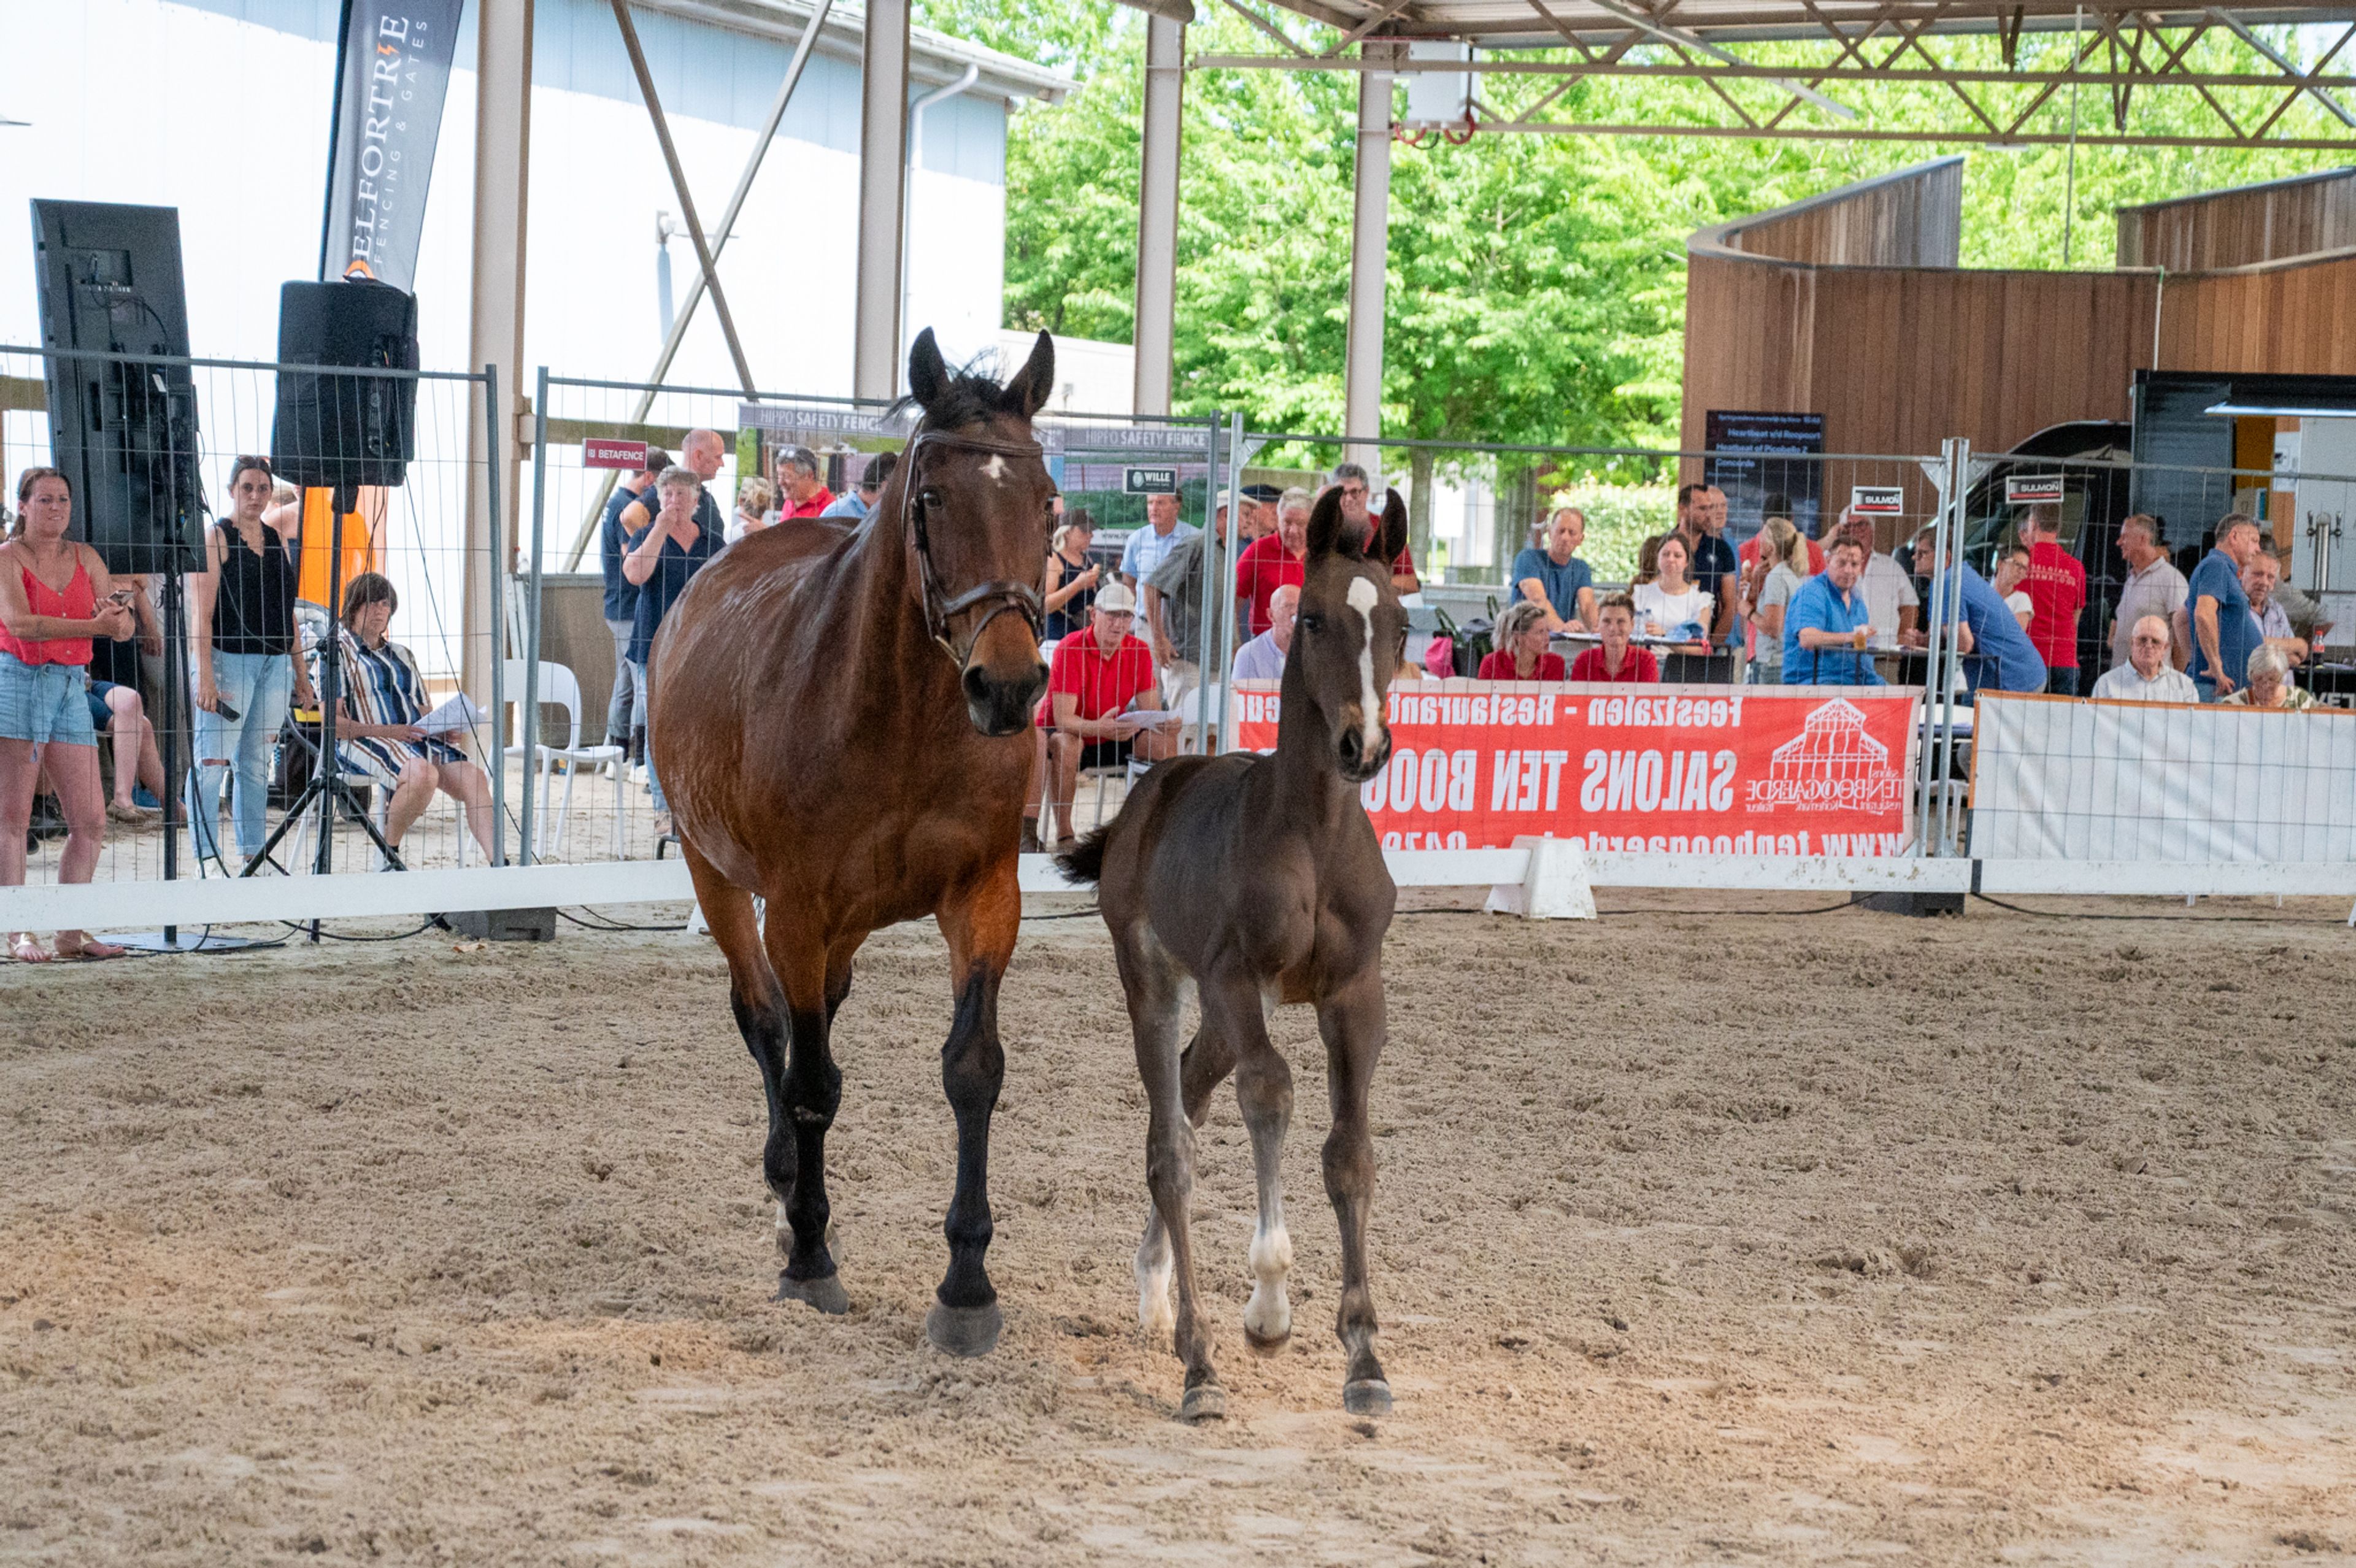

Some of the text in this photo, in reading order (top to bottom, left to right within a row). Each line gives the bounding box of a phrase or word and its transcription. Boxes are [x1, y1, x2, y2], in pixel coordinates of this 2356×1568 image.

[374, 21, 428, 264] FENCING & GATES
[760, 409, 793, 425] HIPPO
[796, 411, 839, 428] SAFETY
[1085, 431, 1205, 447] HIPPO SAFETY FENCE
[598, 448, 644, 461] BETAFENCE
[1144, 471, 1171, 482] WILLE
